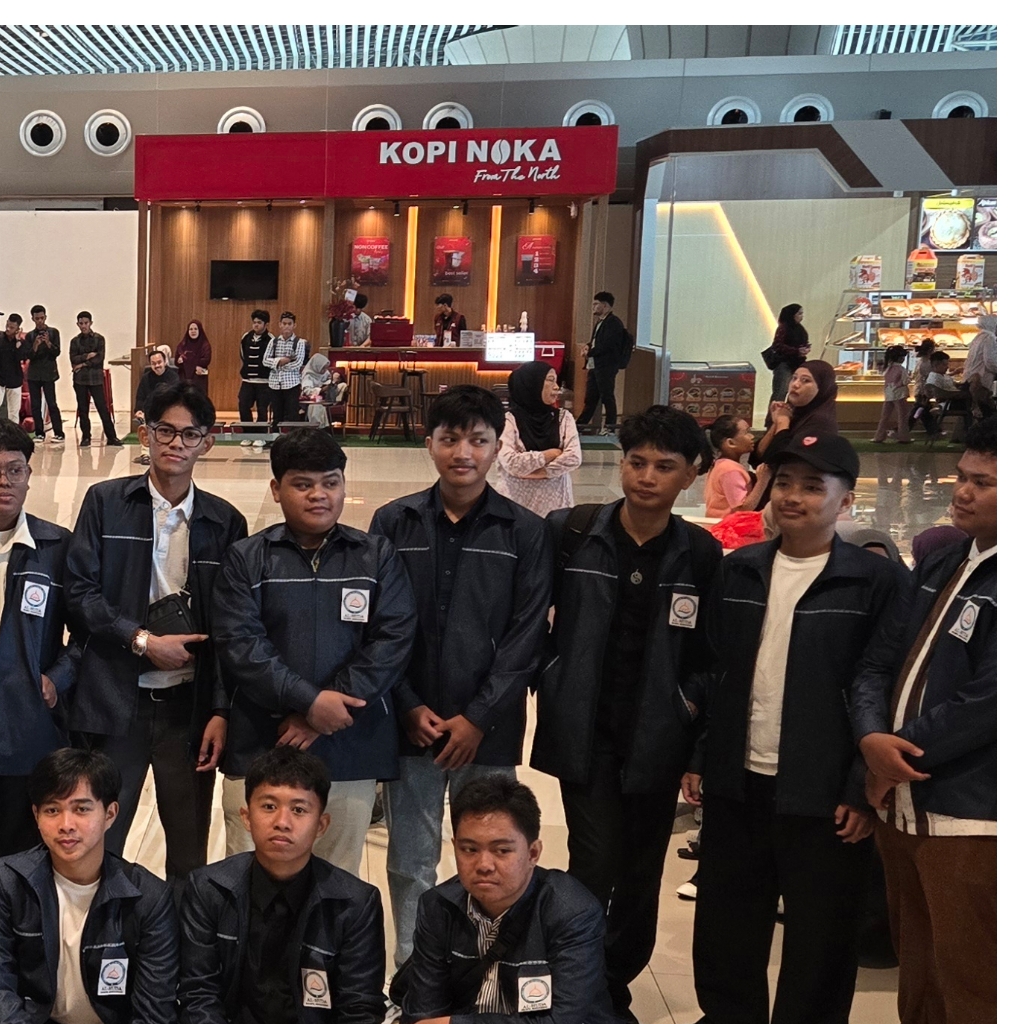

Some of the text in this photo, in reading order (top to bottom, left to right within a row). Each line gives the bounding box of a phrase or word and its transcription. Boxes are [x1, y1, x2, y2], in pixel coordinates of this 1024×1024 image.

[379, 140, 457, 165] KOPI
[473, 165, 561, 183] From The North
